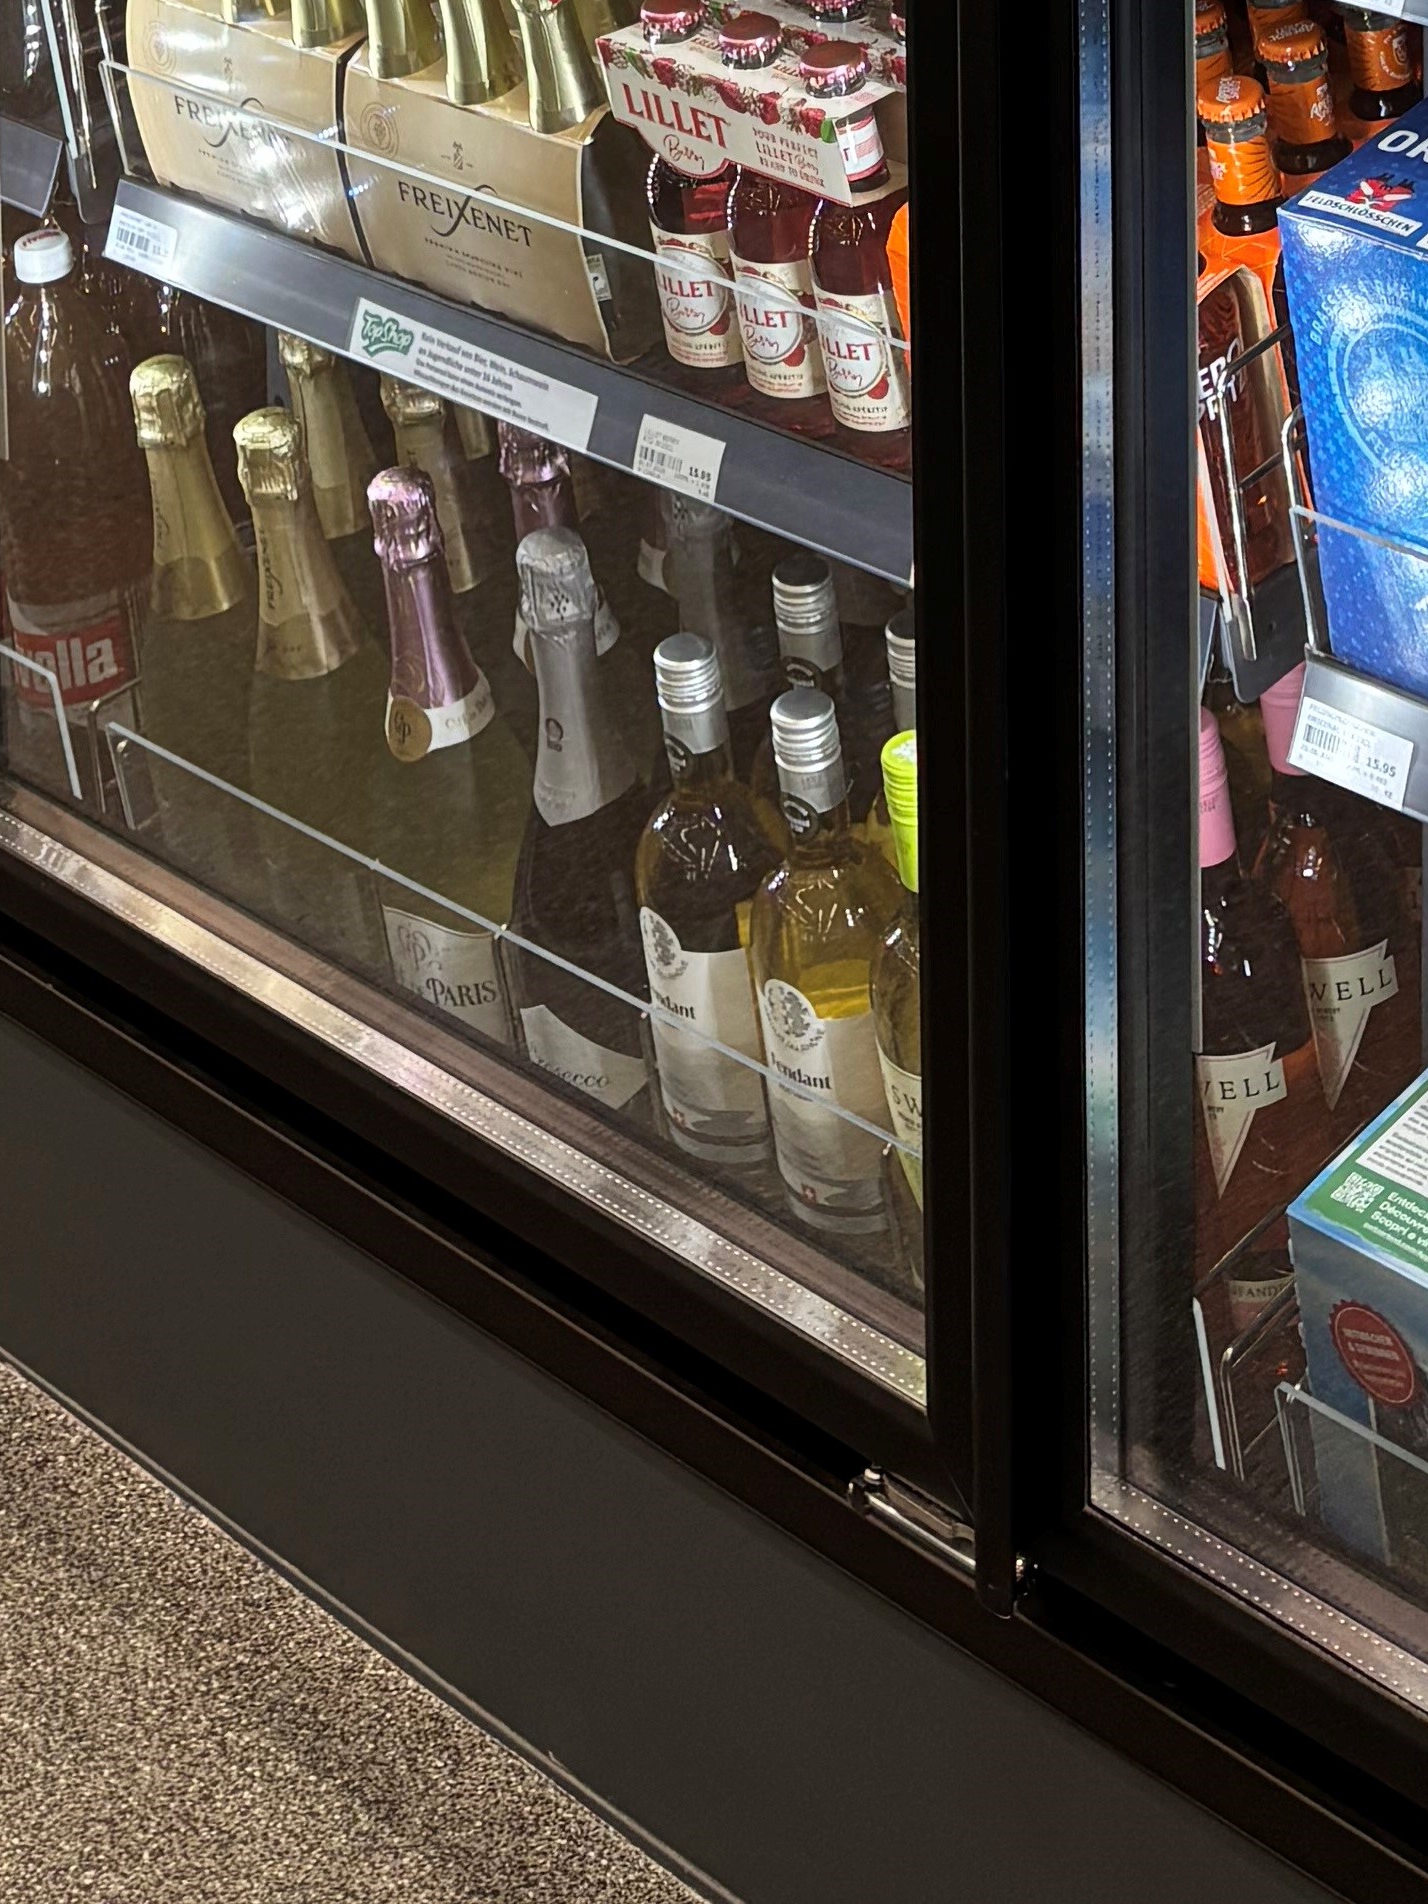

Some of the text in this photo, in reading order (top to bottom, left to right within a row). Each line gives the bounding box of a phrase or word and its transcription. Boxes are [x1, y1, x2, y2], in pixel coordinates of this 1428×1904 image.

[622, 83, 730, 148] LILLET
[397, 181, 533, 249] FREIXENET
[1364, 757, 1398, 779] 15.95
